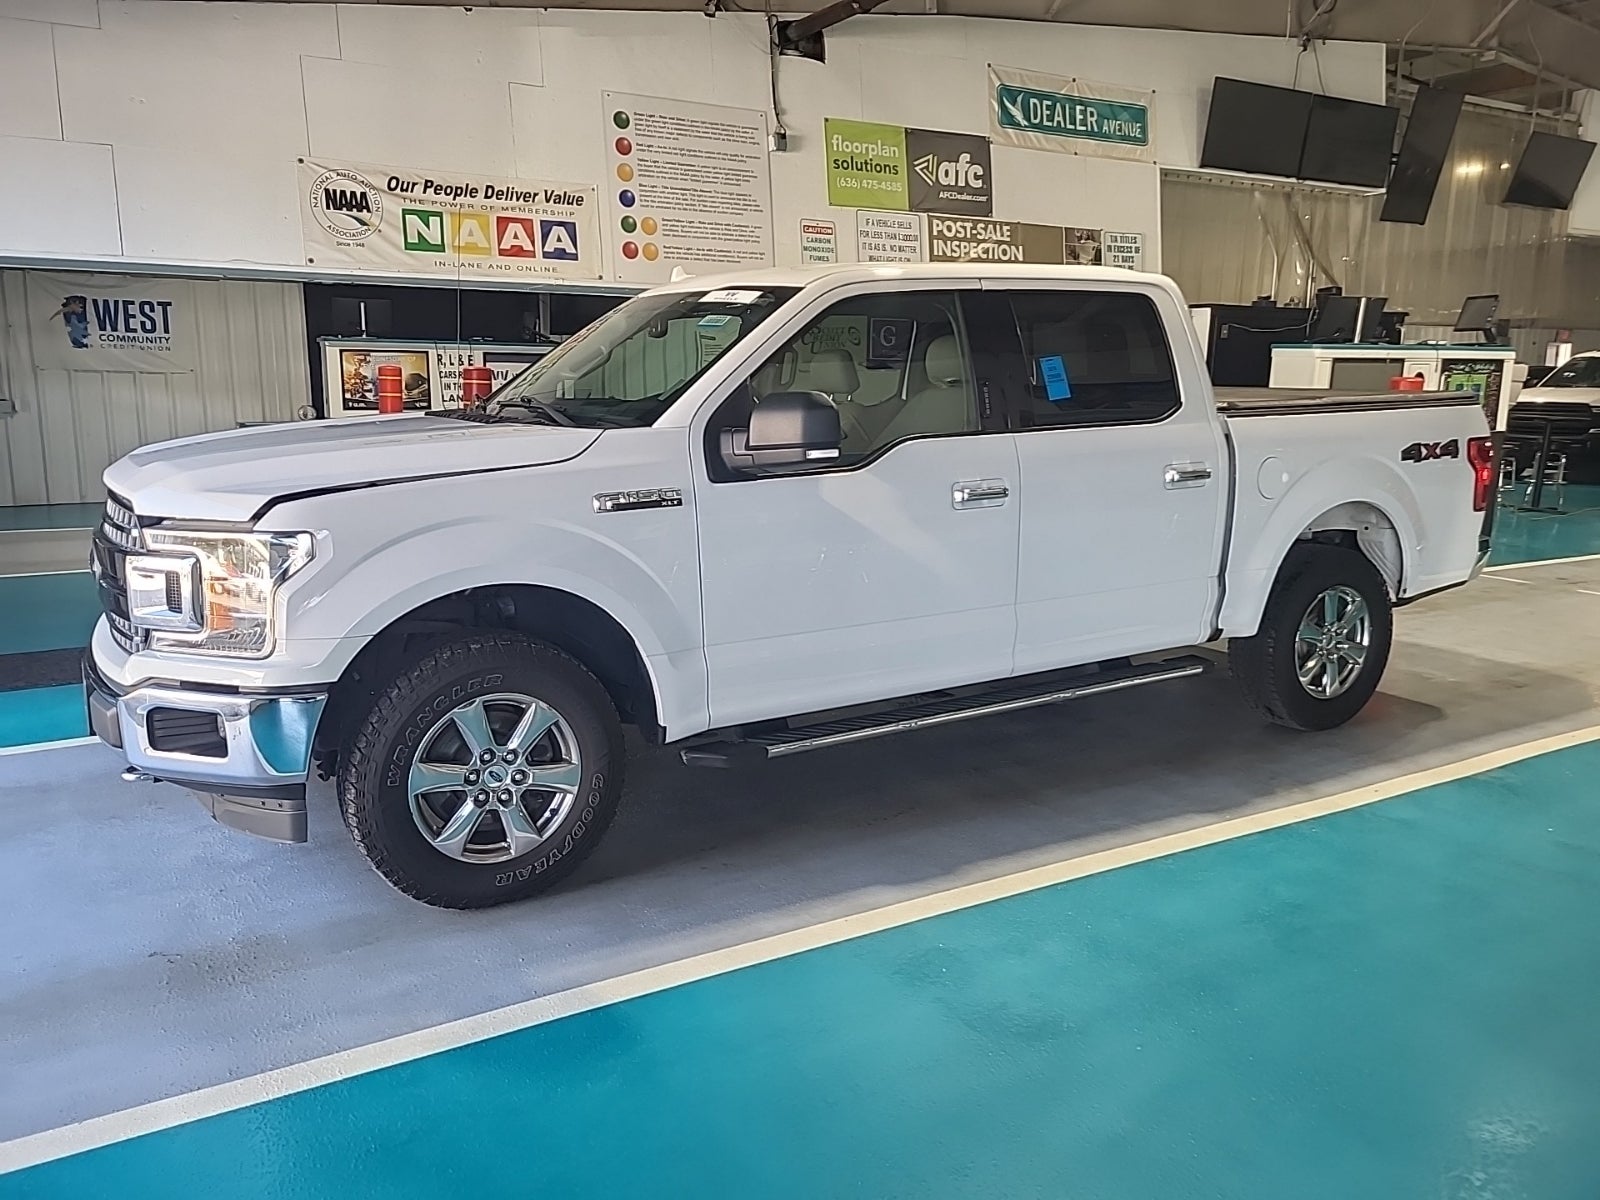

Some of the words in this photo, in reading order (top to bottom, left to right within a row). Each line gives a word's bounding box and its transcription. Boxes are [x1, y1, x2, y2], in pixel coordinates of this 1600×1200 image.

[1029, 97, 1098, 132] DEALER
[1102, 118, 1142, 138] AVENUE
[831, 134, 899, 158] floorplan
[833, 155, 899, 176] solutions
[937, 153, 984, 188] afc
[312, 172, 333, 208] NATIONAL
[336, 171, 358, 181] AUTO
[359, 179, 382, 213] AUCTION
[386, 175, 418, 194] Our
[422, 179, 478, 201] People
[483, 184, 539, 205] Deliver
[543, 189, 585, 207] Value
[836, 176, 861, 189] (636)
[862, 179, 902, 192] 475-4585
[323, 187, 372, 213] NAAA
[402, 197, 425, 206] THE
[431, 200, 475, 210] POWER
[501, 206, 576, 217] MEMBERSHIP
[326, 224, 371, 239] ASSOCIATION
[804, 225, 832, 234] CAUTION
[859, 229, 870, 238] FOR
[871, 230, 883, 239] LESS
[884, 232, 897, 240] THAN
[932, 219, 1011, 242] POST-SALE
[803, 245, 834, 254] MONOXIDE
[806, 236, 831, 244] CARBON
[809, 254, 830, 262] FUMES
[933, 239, 1024, 262] INSPECTION
[434, 260, 483, 269] IN-LANE
[487, 263, 511, 271] AND
[516, 264, 559, 274] ONLINE
[91, 298, 173, 334] WEST
[98, 333, 171, 345] COMMUNITY
[880, 325, 896, 347] G
[437, 353, 447, 368] R,
[449, 354, 454, 366] L
[458, 354, 464, 366] &
[468, 354, 474, 366] E
[440, 370, 457, 379] CARS
[444, 382, 451, 390] IN
[442, 394, 464, 402] LAN
[386, 673, 504, 788] WRANGLER
[495, 772, 605, 887] GOODYEAR
